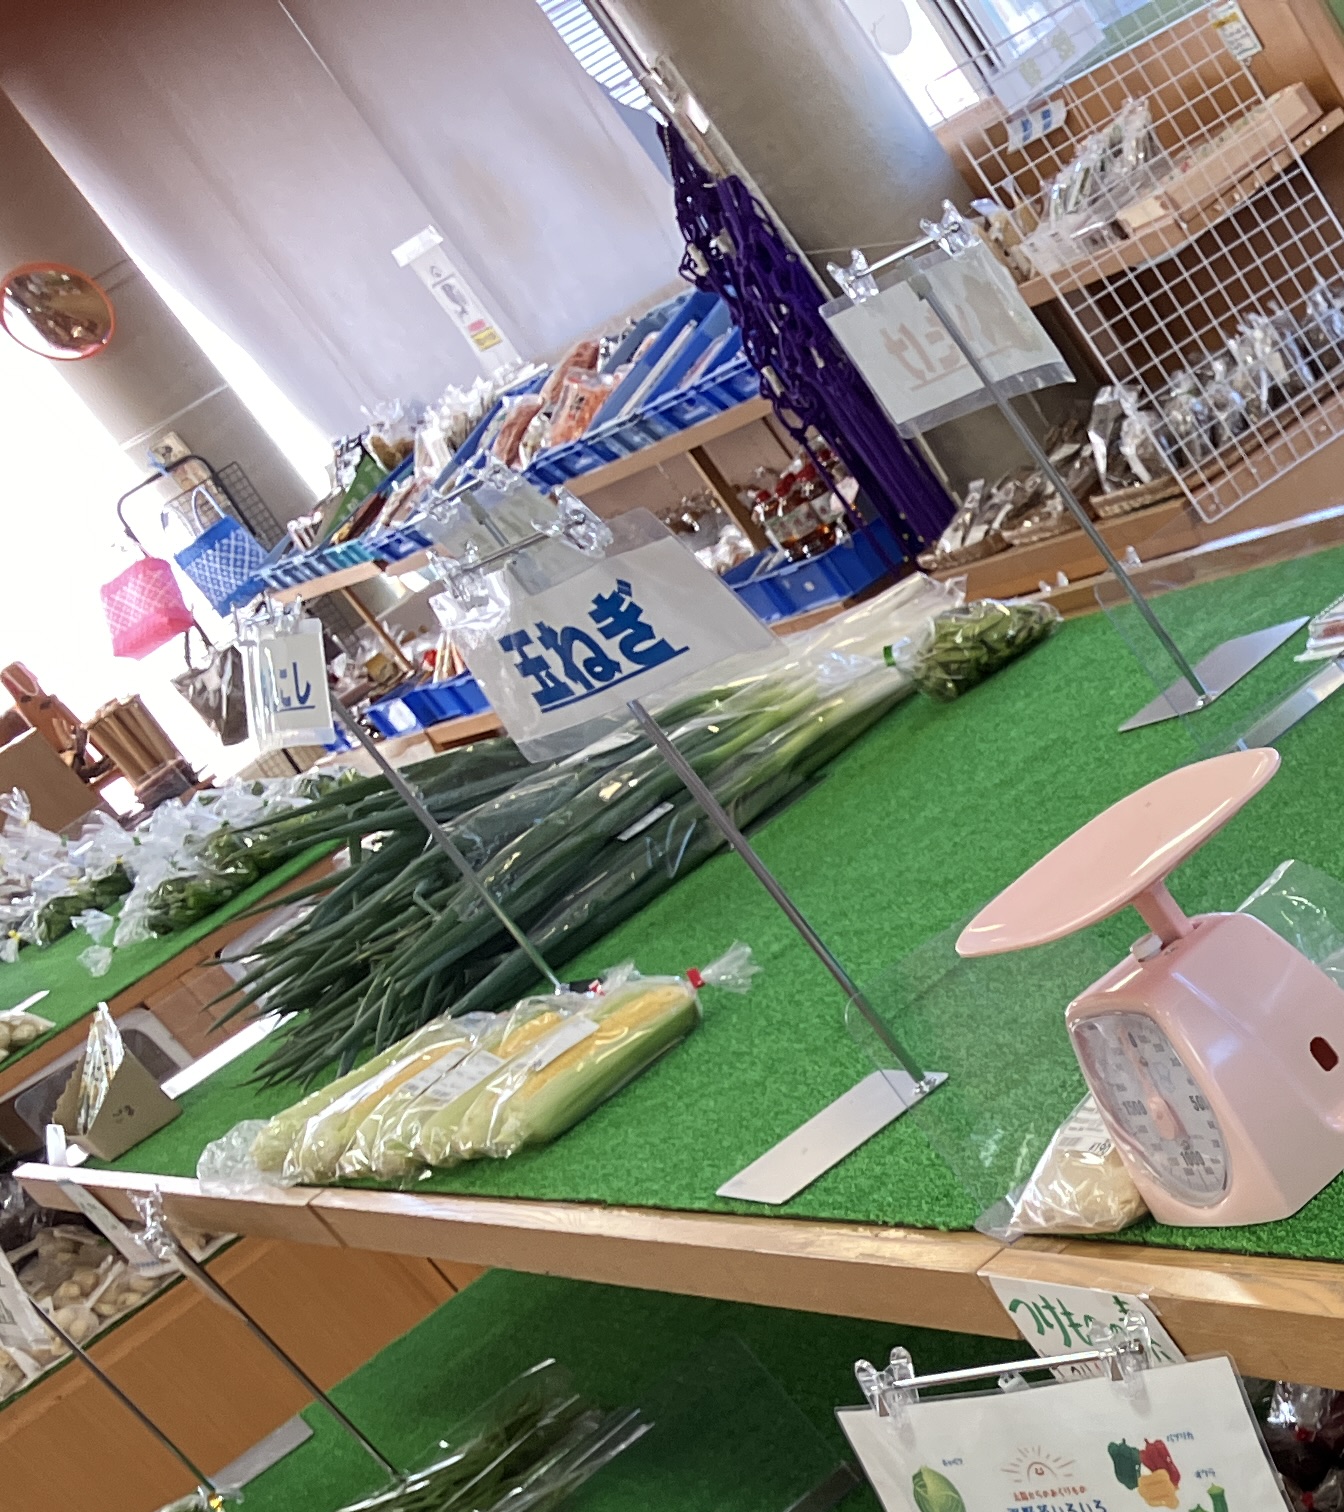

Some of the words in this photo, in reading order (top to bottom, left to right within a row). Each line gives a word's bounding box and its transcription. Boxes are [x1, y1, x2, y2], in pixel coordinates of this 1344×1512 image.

[500, 578, 678, 706] 玉ねぎ
[1180, 1151, 1205, 1166] 1000
